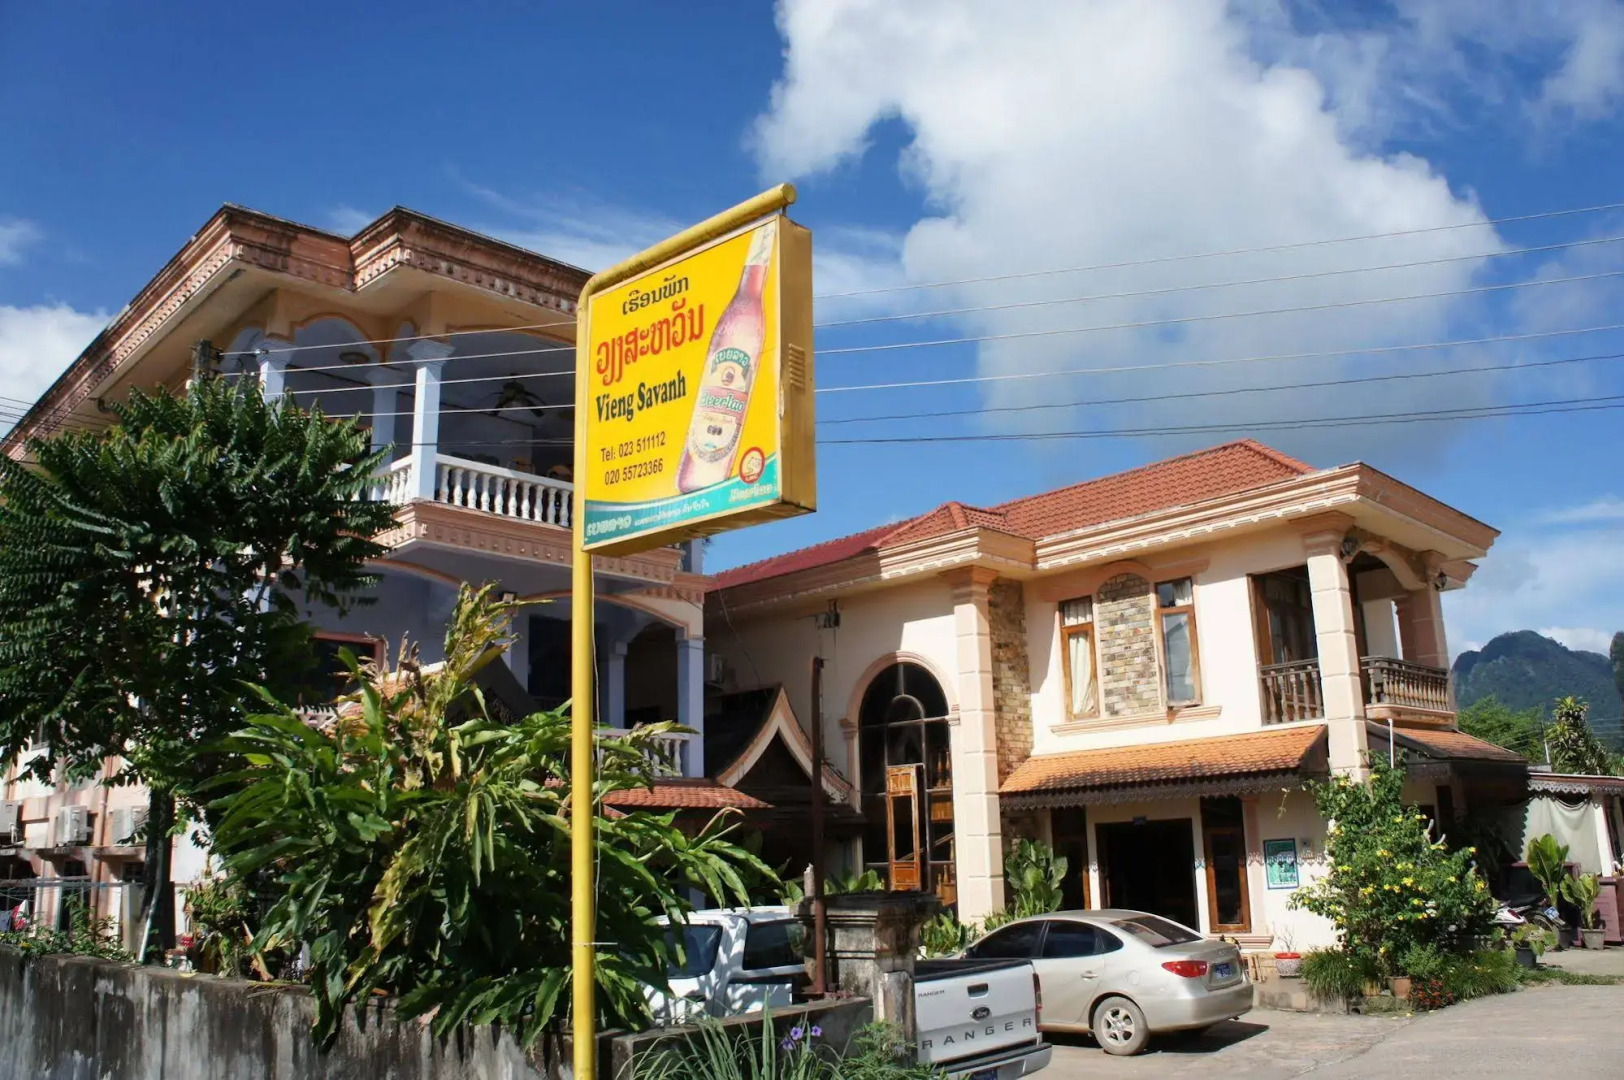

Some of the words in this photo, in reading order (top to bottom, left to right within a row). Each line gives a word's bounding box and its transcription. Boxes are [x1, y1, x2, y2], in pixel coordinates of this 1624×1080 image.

[595, 392, 635, 422] Vieng
[637, 369, 687, 412] Savanh
[601, 446, 616, 462] Tel:
[618, 441, 634, 458] 023
[636, 431, 666, 453] 511112
[604, 468, 620, 486] 020
[622, 458, 664, 482] 55723366
[918, 989, 945, 998] RANGER
[921, 1017, 1032, 1050] RANGER
